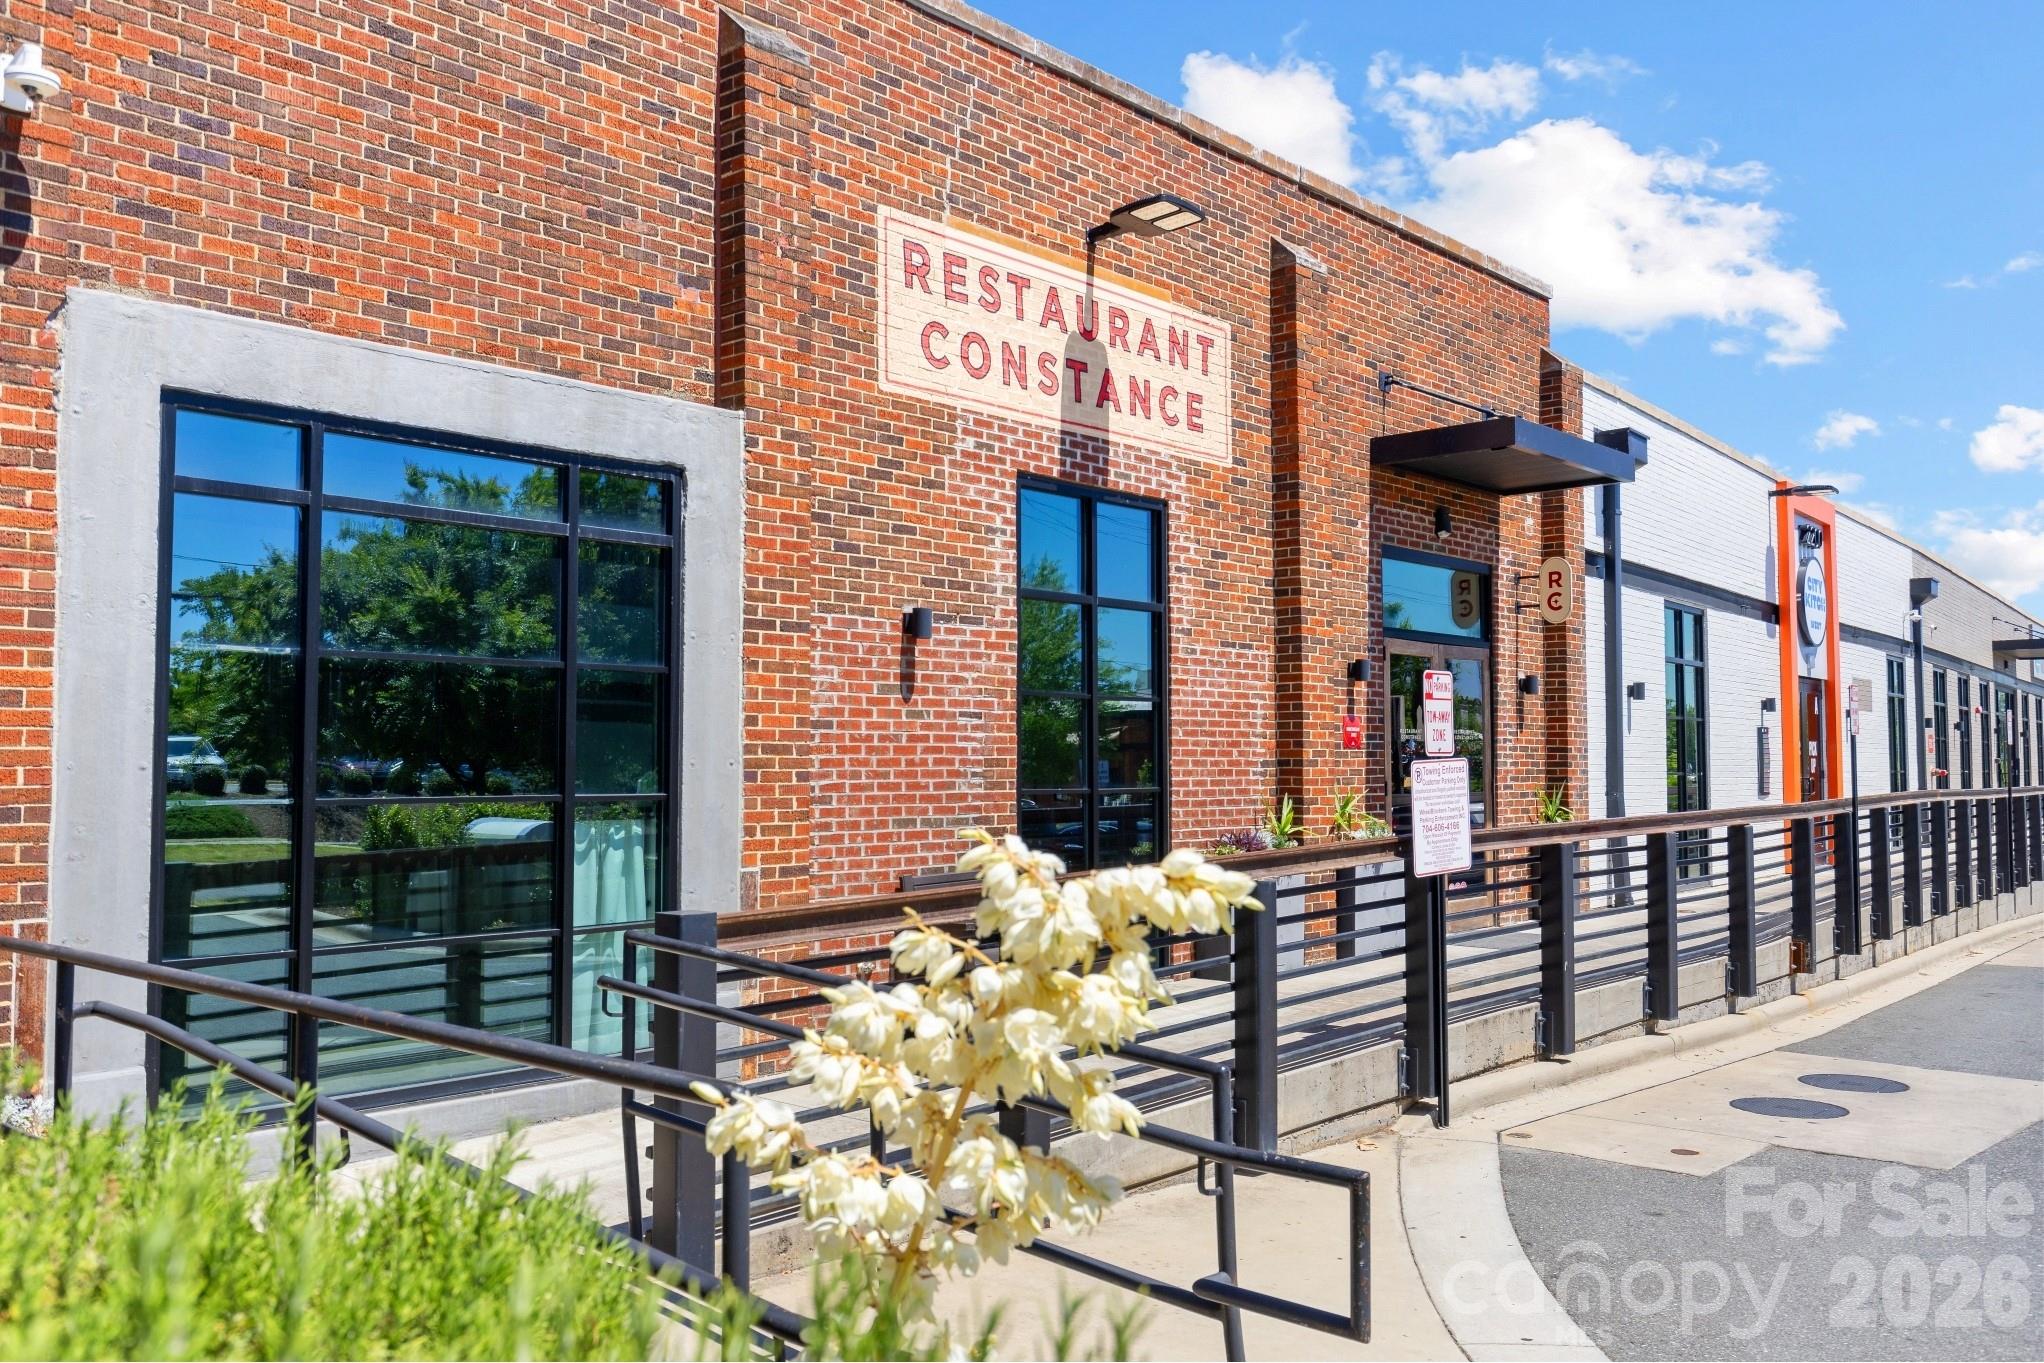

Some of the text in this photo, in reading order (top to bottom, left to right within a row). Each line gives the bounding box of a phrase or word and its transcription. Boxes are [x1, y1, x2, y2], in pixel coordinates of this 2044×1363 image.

[902, 238, 1215, 377] RESTAURANT
[920, 320, 1204, 434] CONSTANCE
[1807, 576, 1823, 594] CITY
[1426, 710, 1451, 724] TOW-AWAY
[1432, 728, 1447, 742] ZONE
[1422, 764, 1465, 777] Towing Enforced
[1441, 777, 1456, 785] Parking
[1456, 776, 1466, 784] Only
